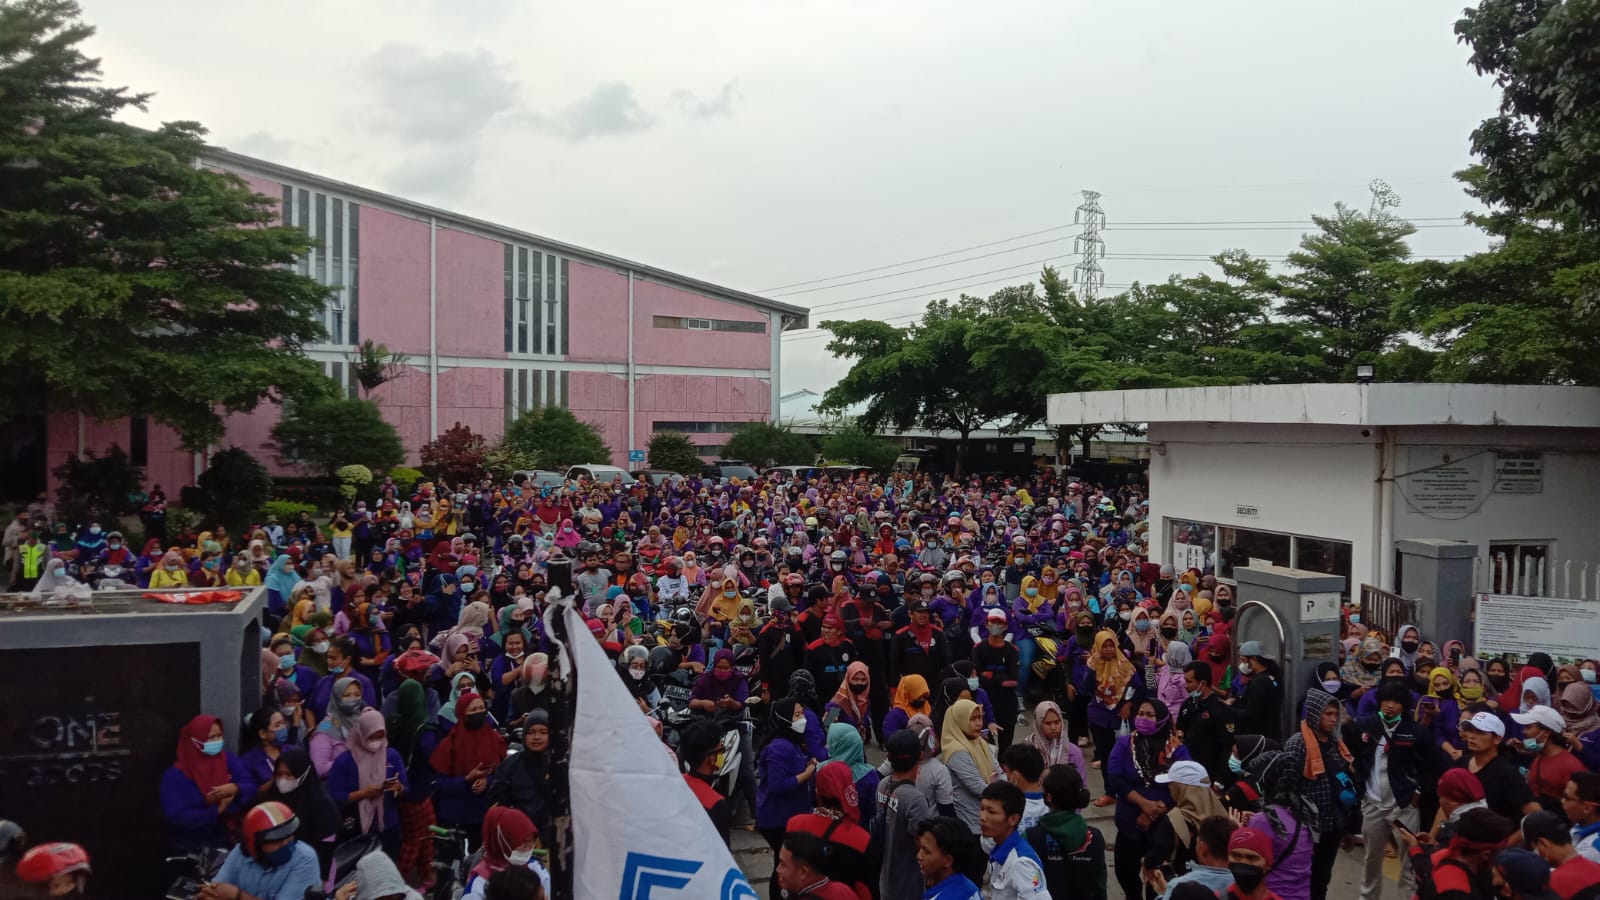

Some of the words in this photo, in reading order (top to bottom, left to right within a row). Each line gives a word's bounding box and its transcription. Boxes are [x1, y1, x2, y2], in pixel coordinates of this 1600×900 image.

[1236, 507, 1258, 516] SECURITY
[1306, 600, 1315, 613] P
[27, 711, 121, 748] ONE
